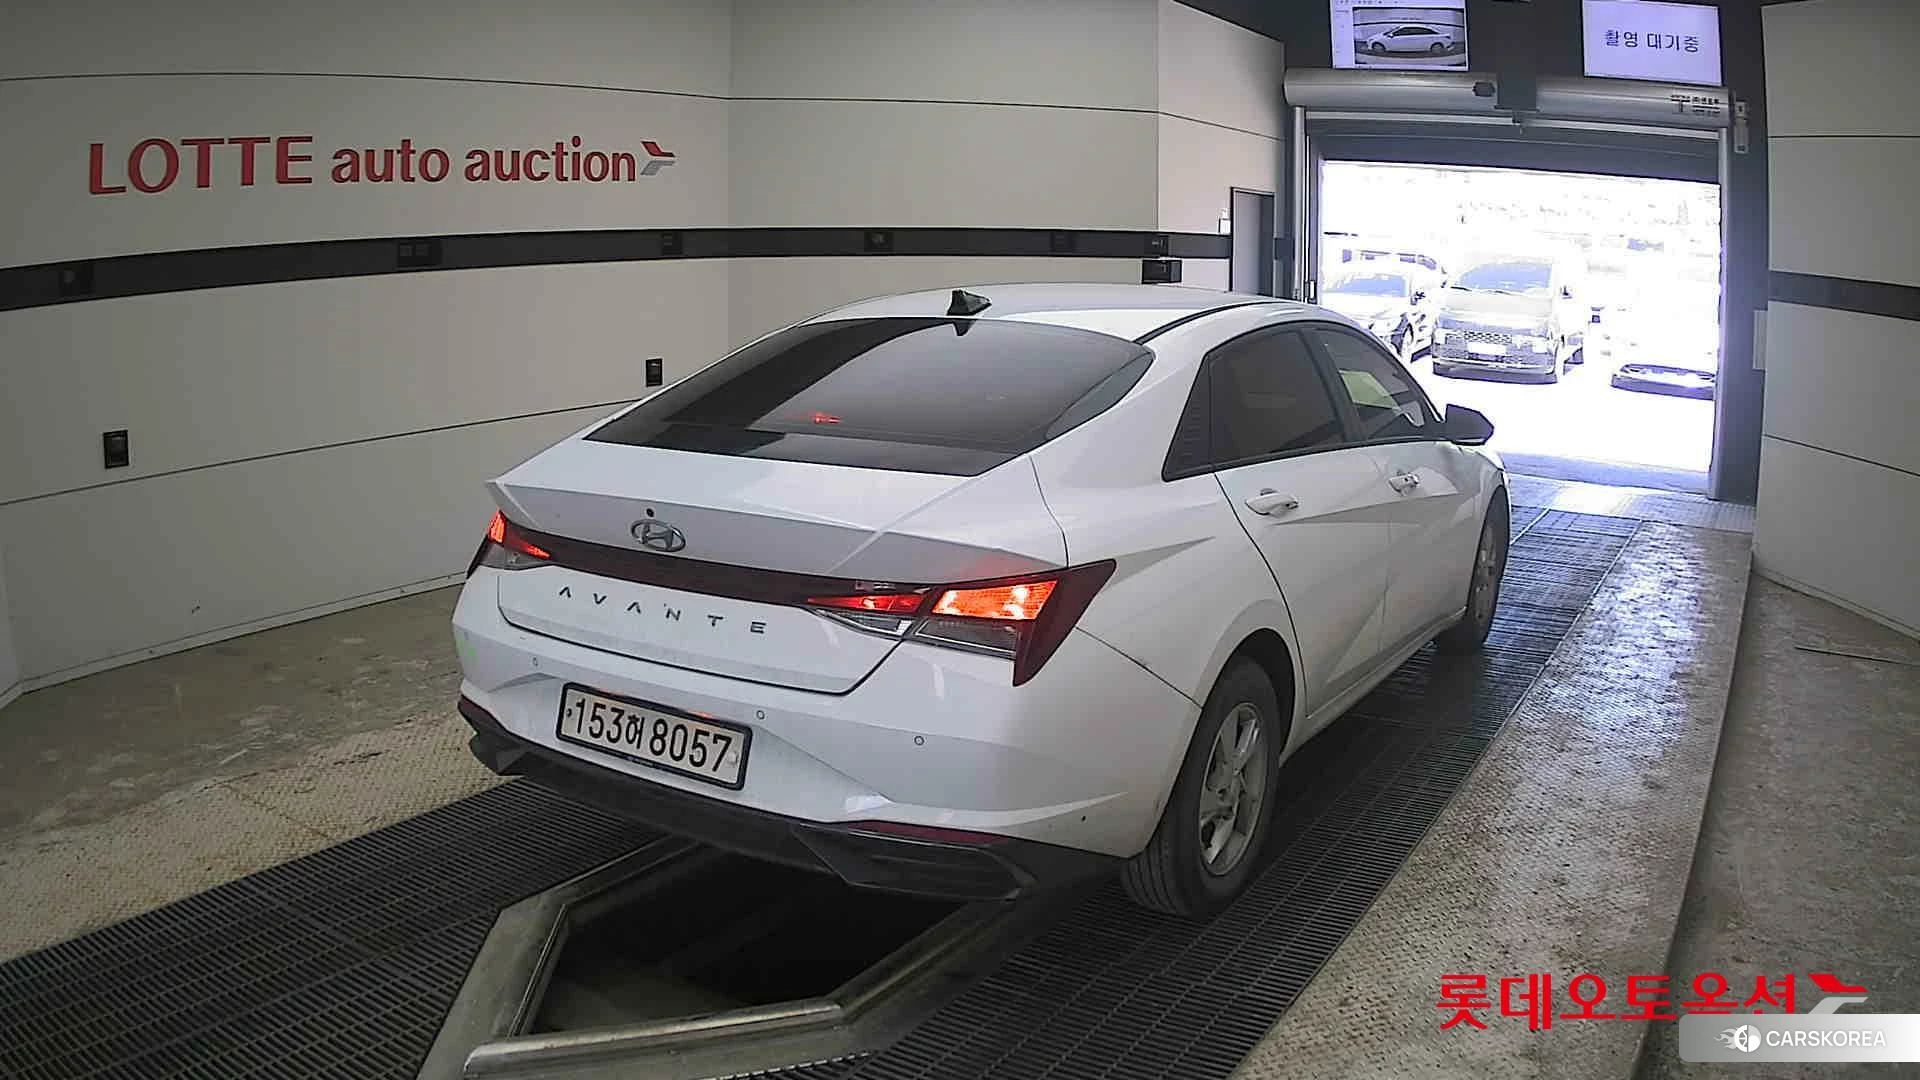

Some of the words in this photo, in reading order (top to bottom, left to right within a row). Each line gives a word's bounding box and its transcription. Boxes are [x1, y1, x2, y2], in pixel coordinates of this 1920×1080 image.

[1605, 30, 1639, 48] 촬영
[1646, 33, 1699, 53] 대기중
[89, 136, 313, 195] LOTTE
[331, 138, 450, 183] auto
[464, 135, 637, 182] auction
[559, 586, 767, 634] AVANTE
